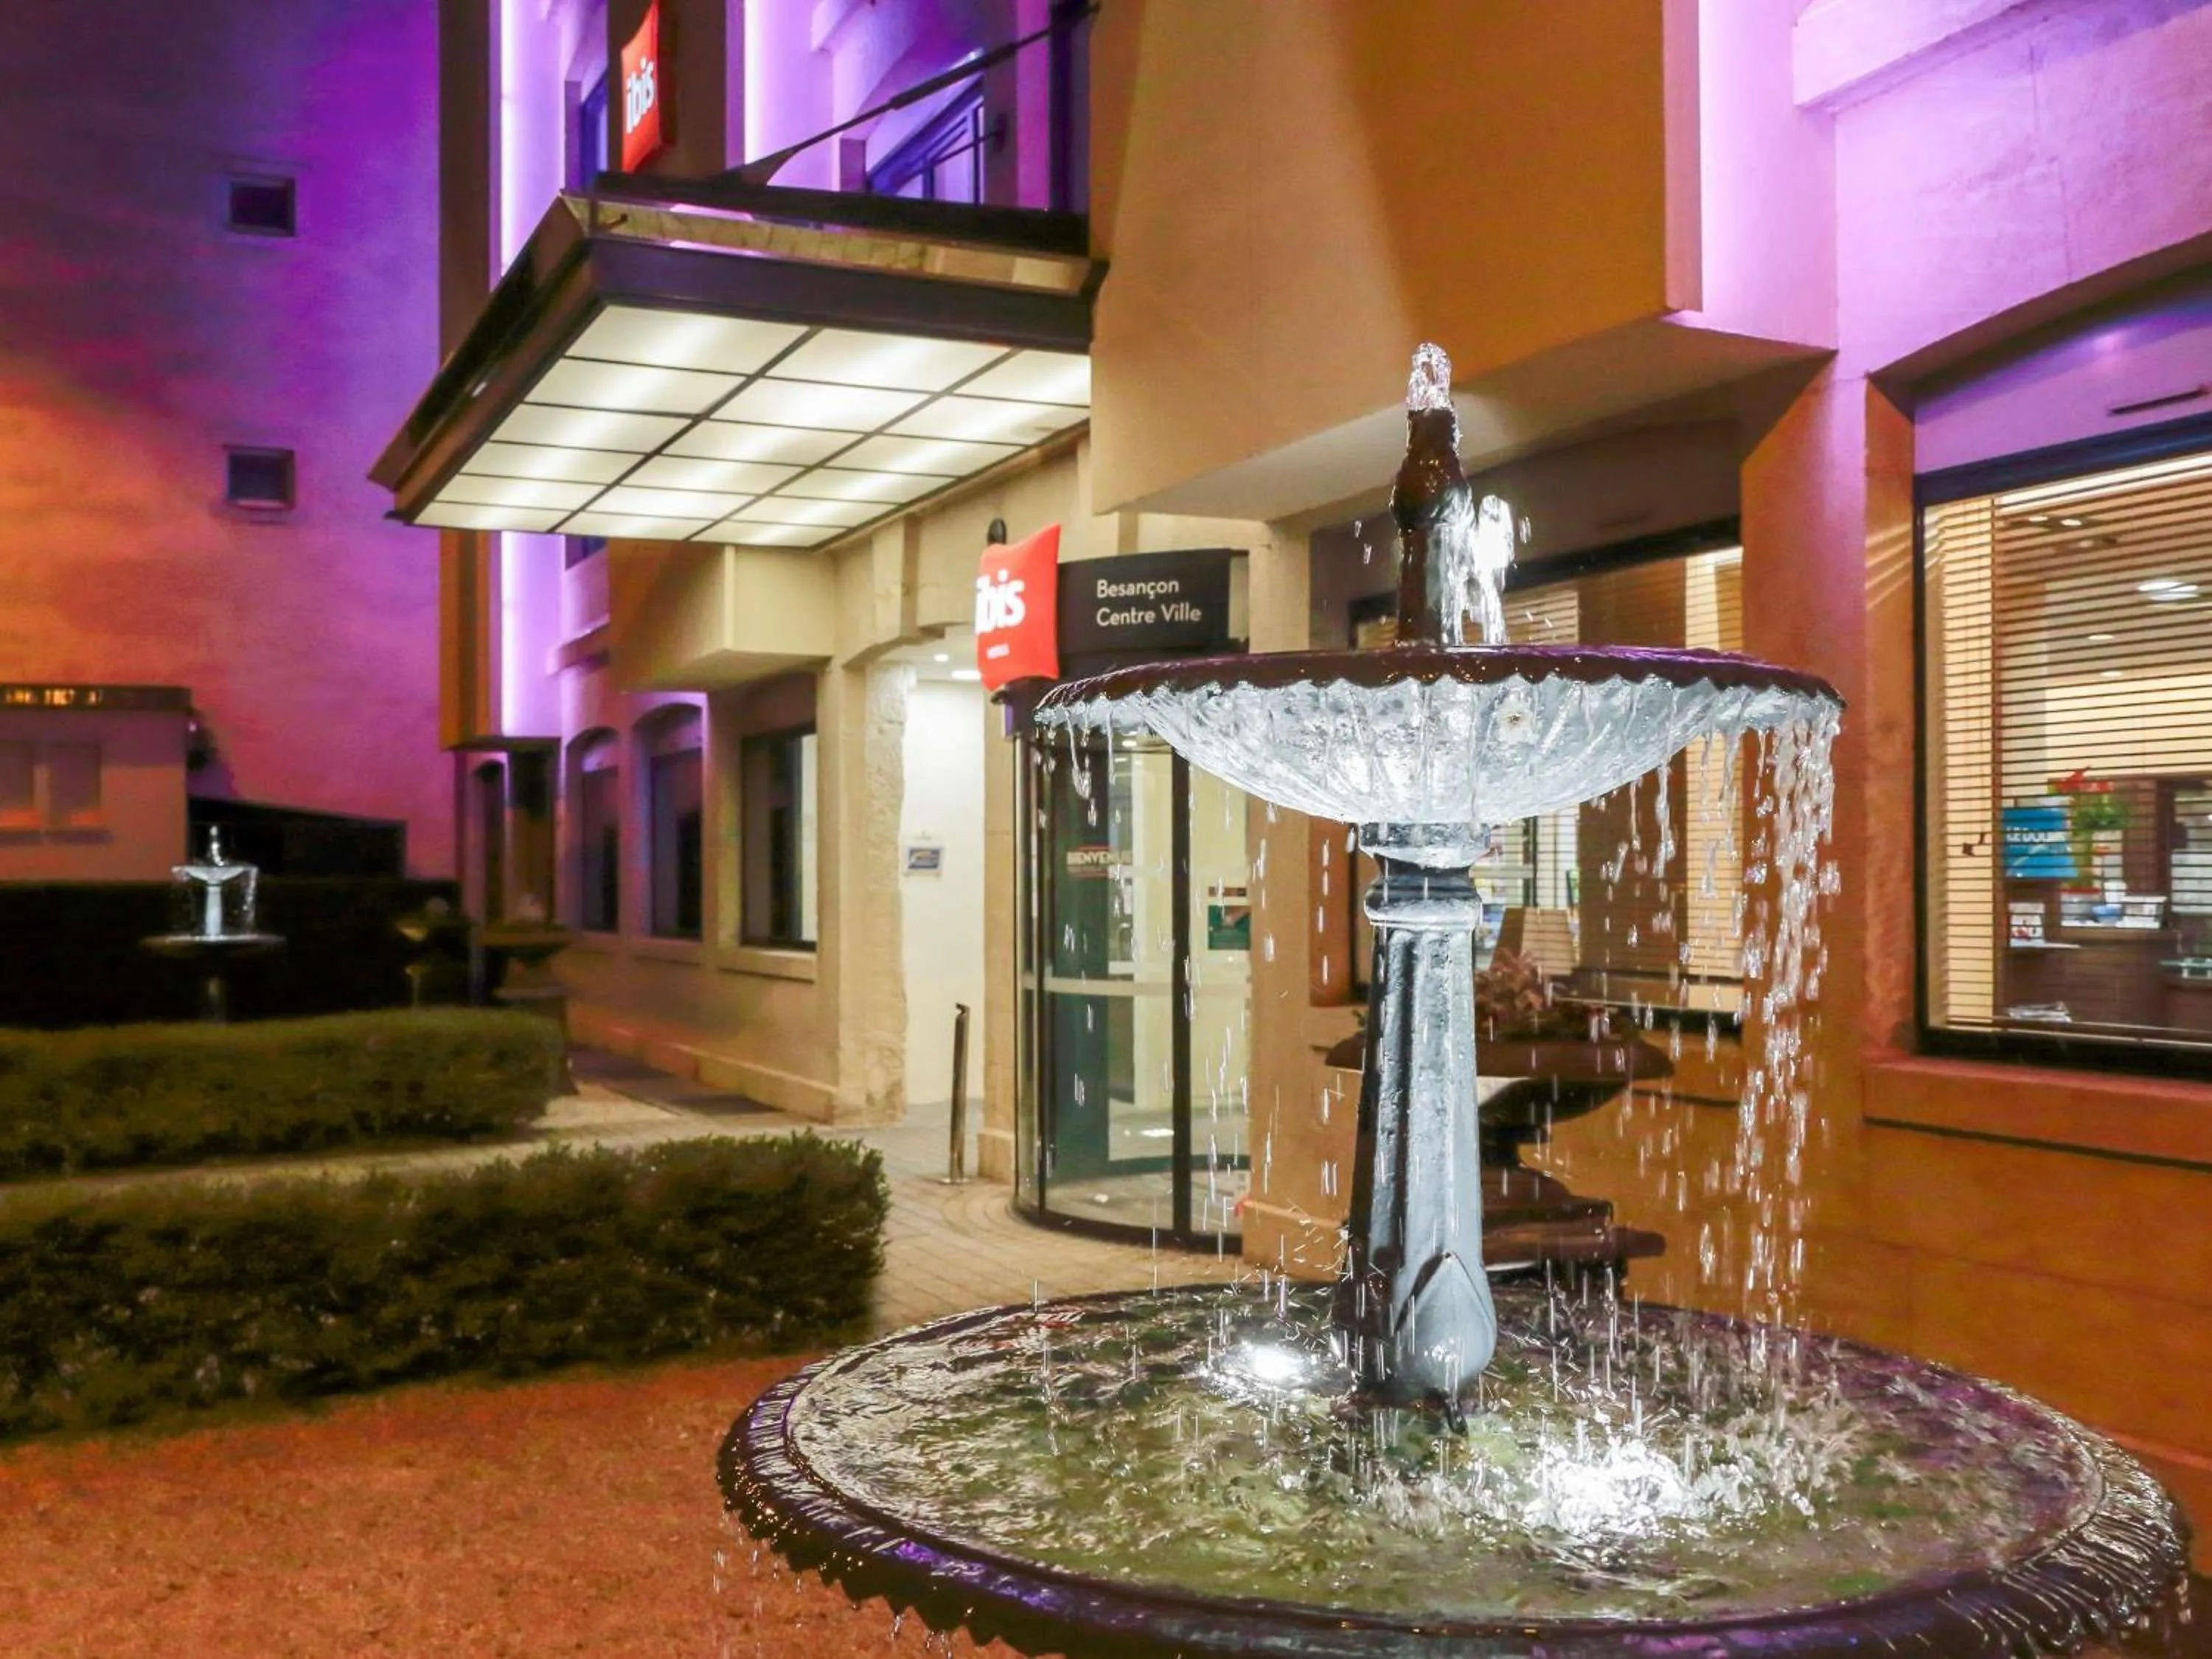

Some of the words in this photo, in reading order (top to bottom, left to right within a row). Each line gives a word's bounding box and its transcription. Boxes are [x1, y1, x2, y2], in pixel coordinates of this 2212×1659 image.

[626, 56, 654, 134] ibis
[1096, 580, 1180, 599] Besançon
[1096, 606, 1156, 626] Centre
[1161, 602, 1203, 622] Ville
